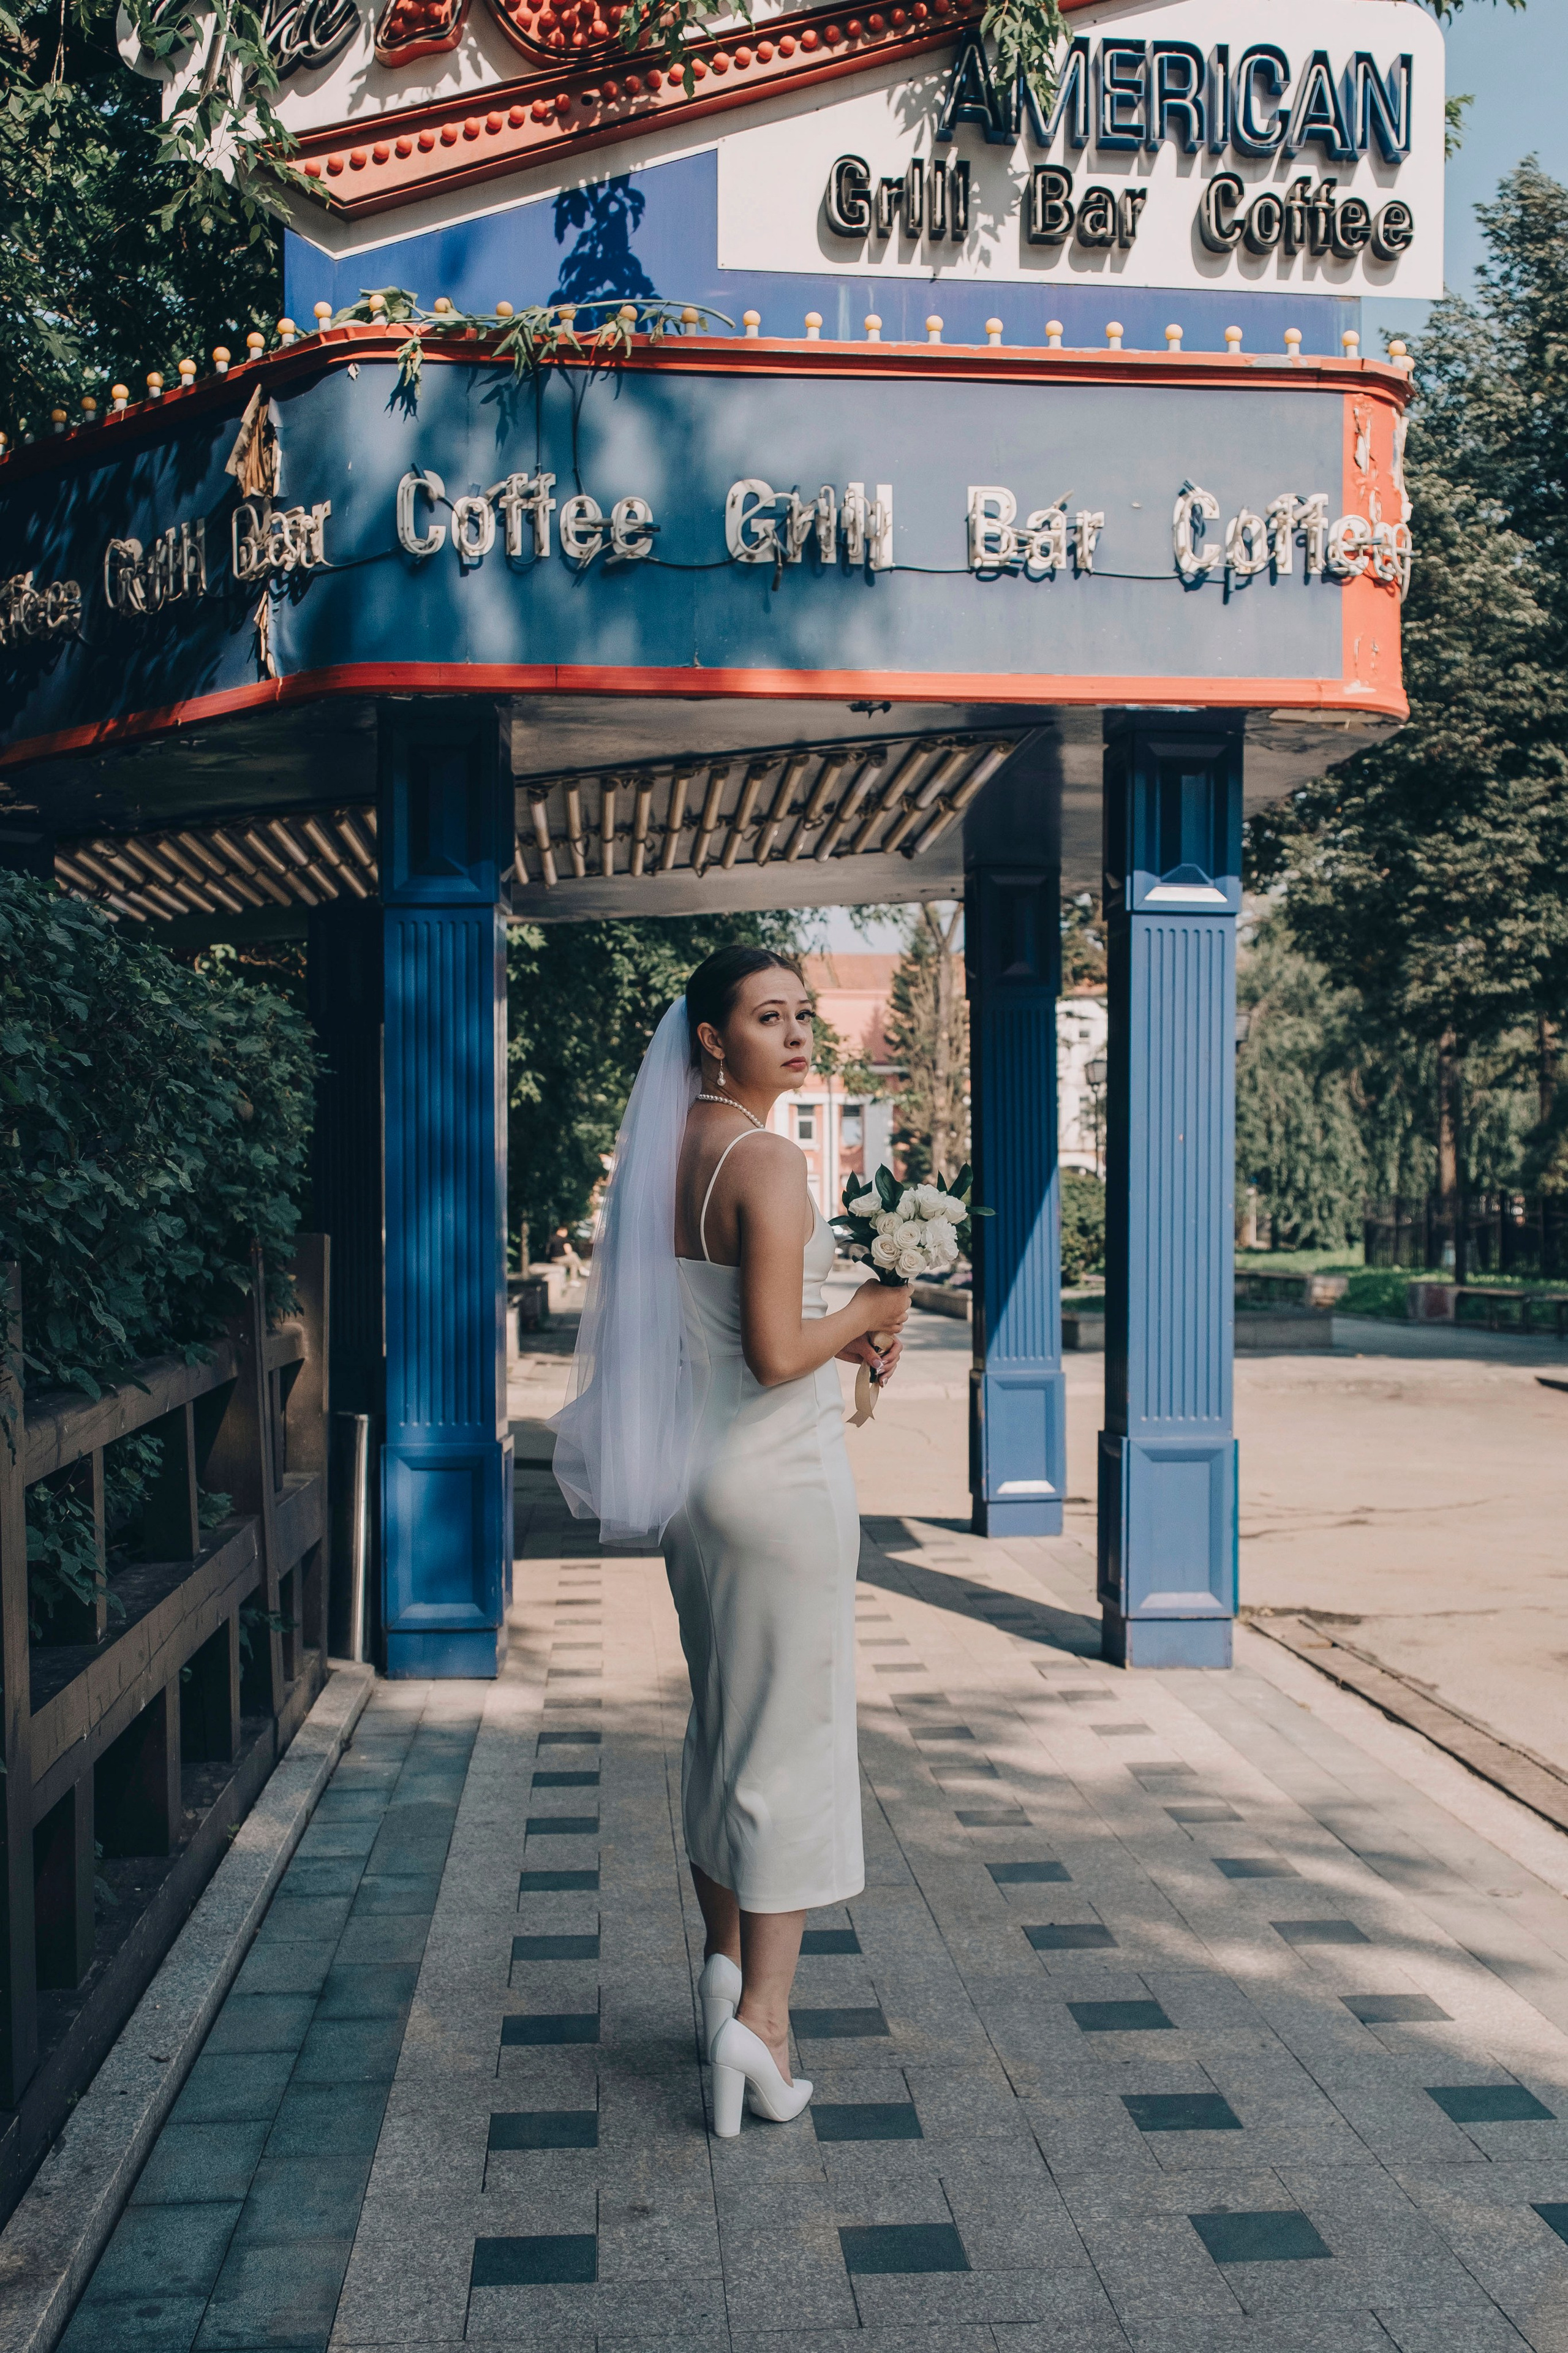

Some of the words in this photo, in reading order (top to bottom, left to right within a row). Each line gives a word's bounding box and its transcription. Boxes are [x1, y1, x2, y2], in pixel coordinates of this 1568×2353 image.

[937, 32, 1412, 163] AMERICAN
[1029, 164, 1147, 247] Bar
[1199, 172, 1414, 261] Coffee
[396, 469, 657, 560] Coffee
[725, 478, 893, 571] Grill
[967, 486, 1105, 571] Bar
[1172, 489, 1414, 581] Coffee
